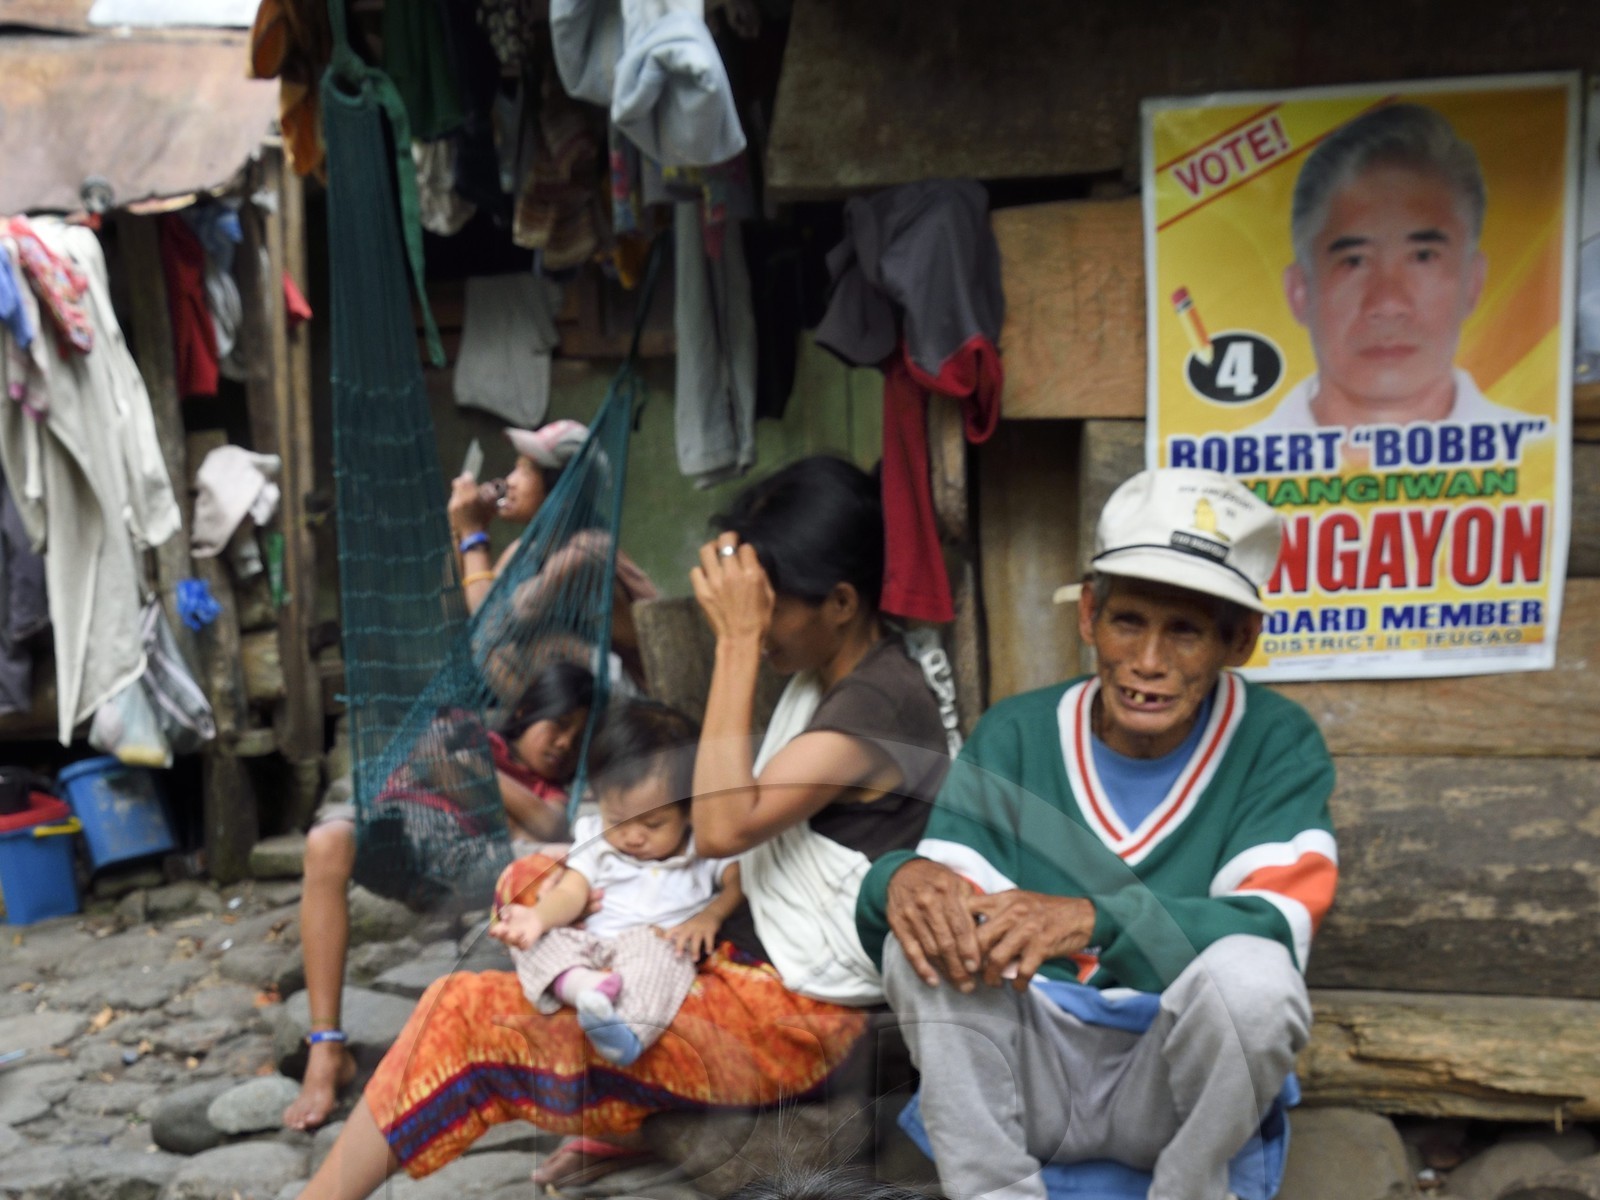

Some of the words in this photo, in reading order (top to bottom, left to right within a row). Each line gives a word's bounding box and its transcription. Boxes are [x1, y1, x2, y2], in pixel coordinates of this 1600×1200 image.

[1173, 117, 1290, 196] VOTE!
[1215, 341, 1258, 396] 4
[1171, 432, 1343, 474] ROBERT
[1267, 505, 1545, 594] NGAYON
[1263, 635, 1376, 654] DISTRICT
[1426, 628, 1523, 647] IFUGAO
[1268, 606, 1367, 635] OARD
[1382, 600, 1543, 630] MEMBER
